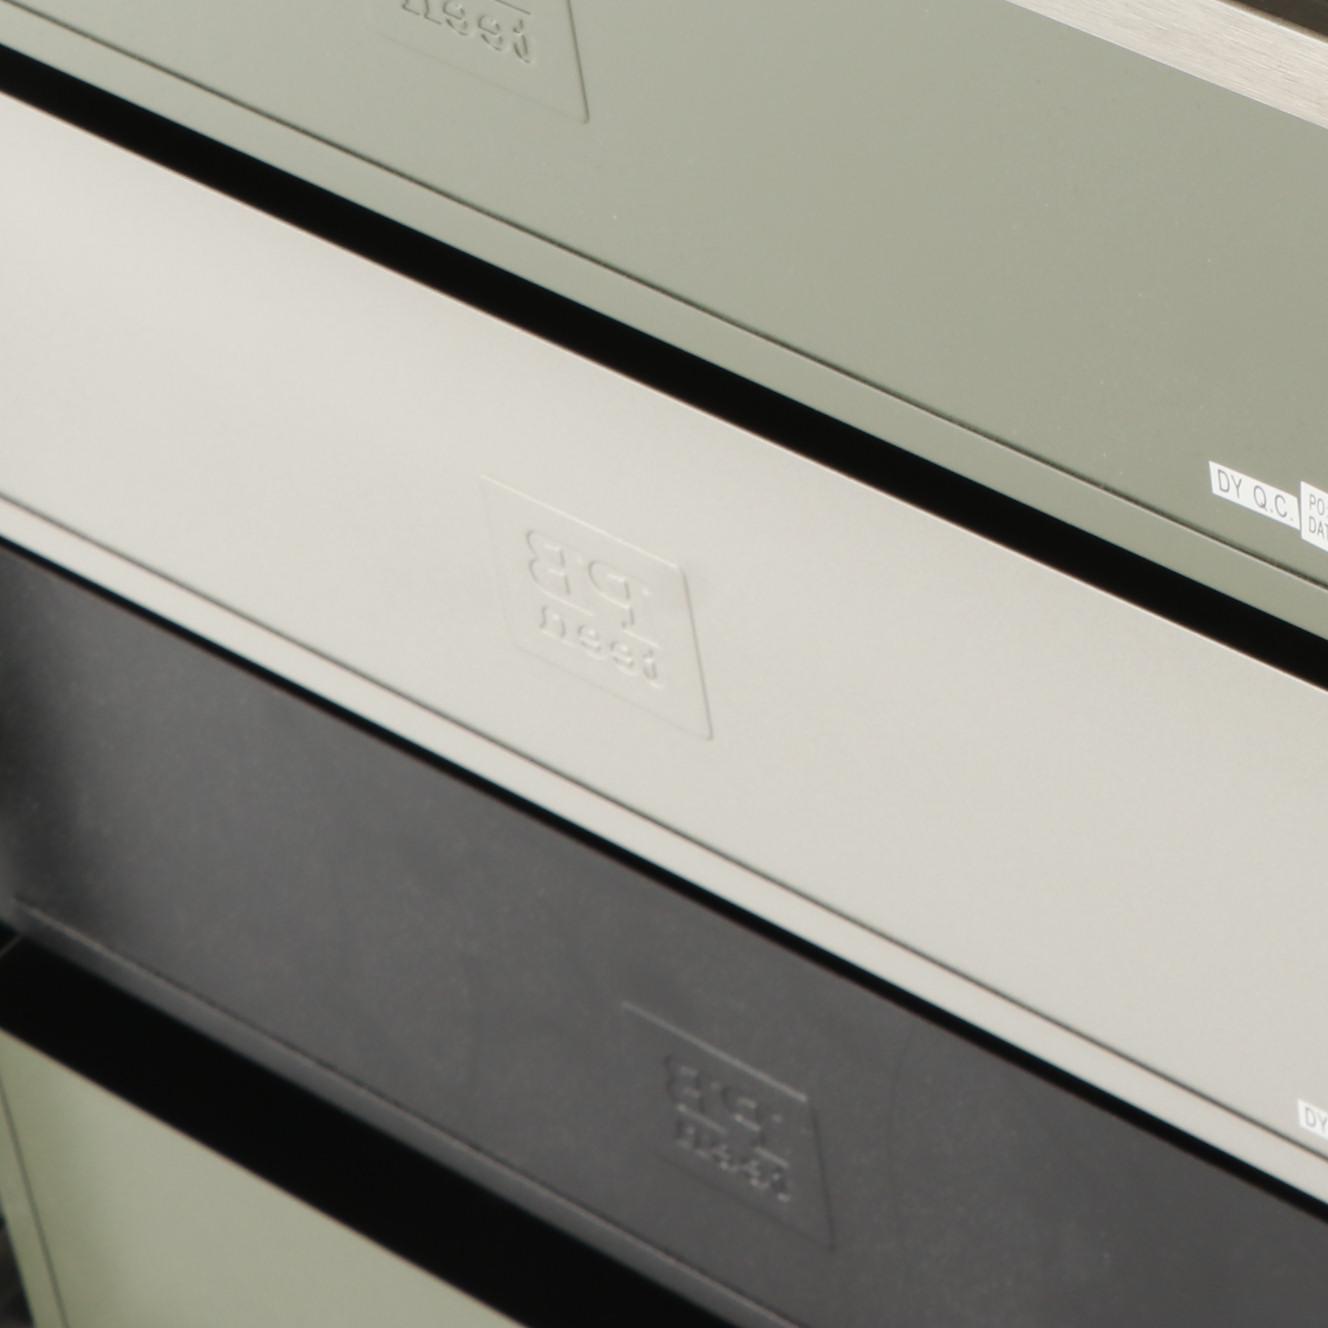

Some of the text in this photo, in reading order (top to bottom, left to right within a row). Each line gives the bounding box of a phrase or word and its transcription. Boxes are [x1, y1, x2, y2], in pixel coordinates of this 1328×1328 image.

[1217, 468, 1295, 522] DY Q.C.
[1304, 1106, 1328, 1133] DY
